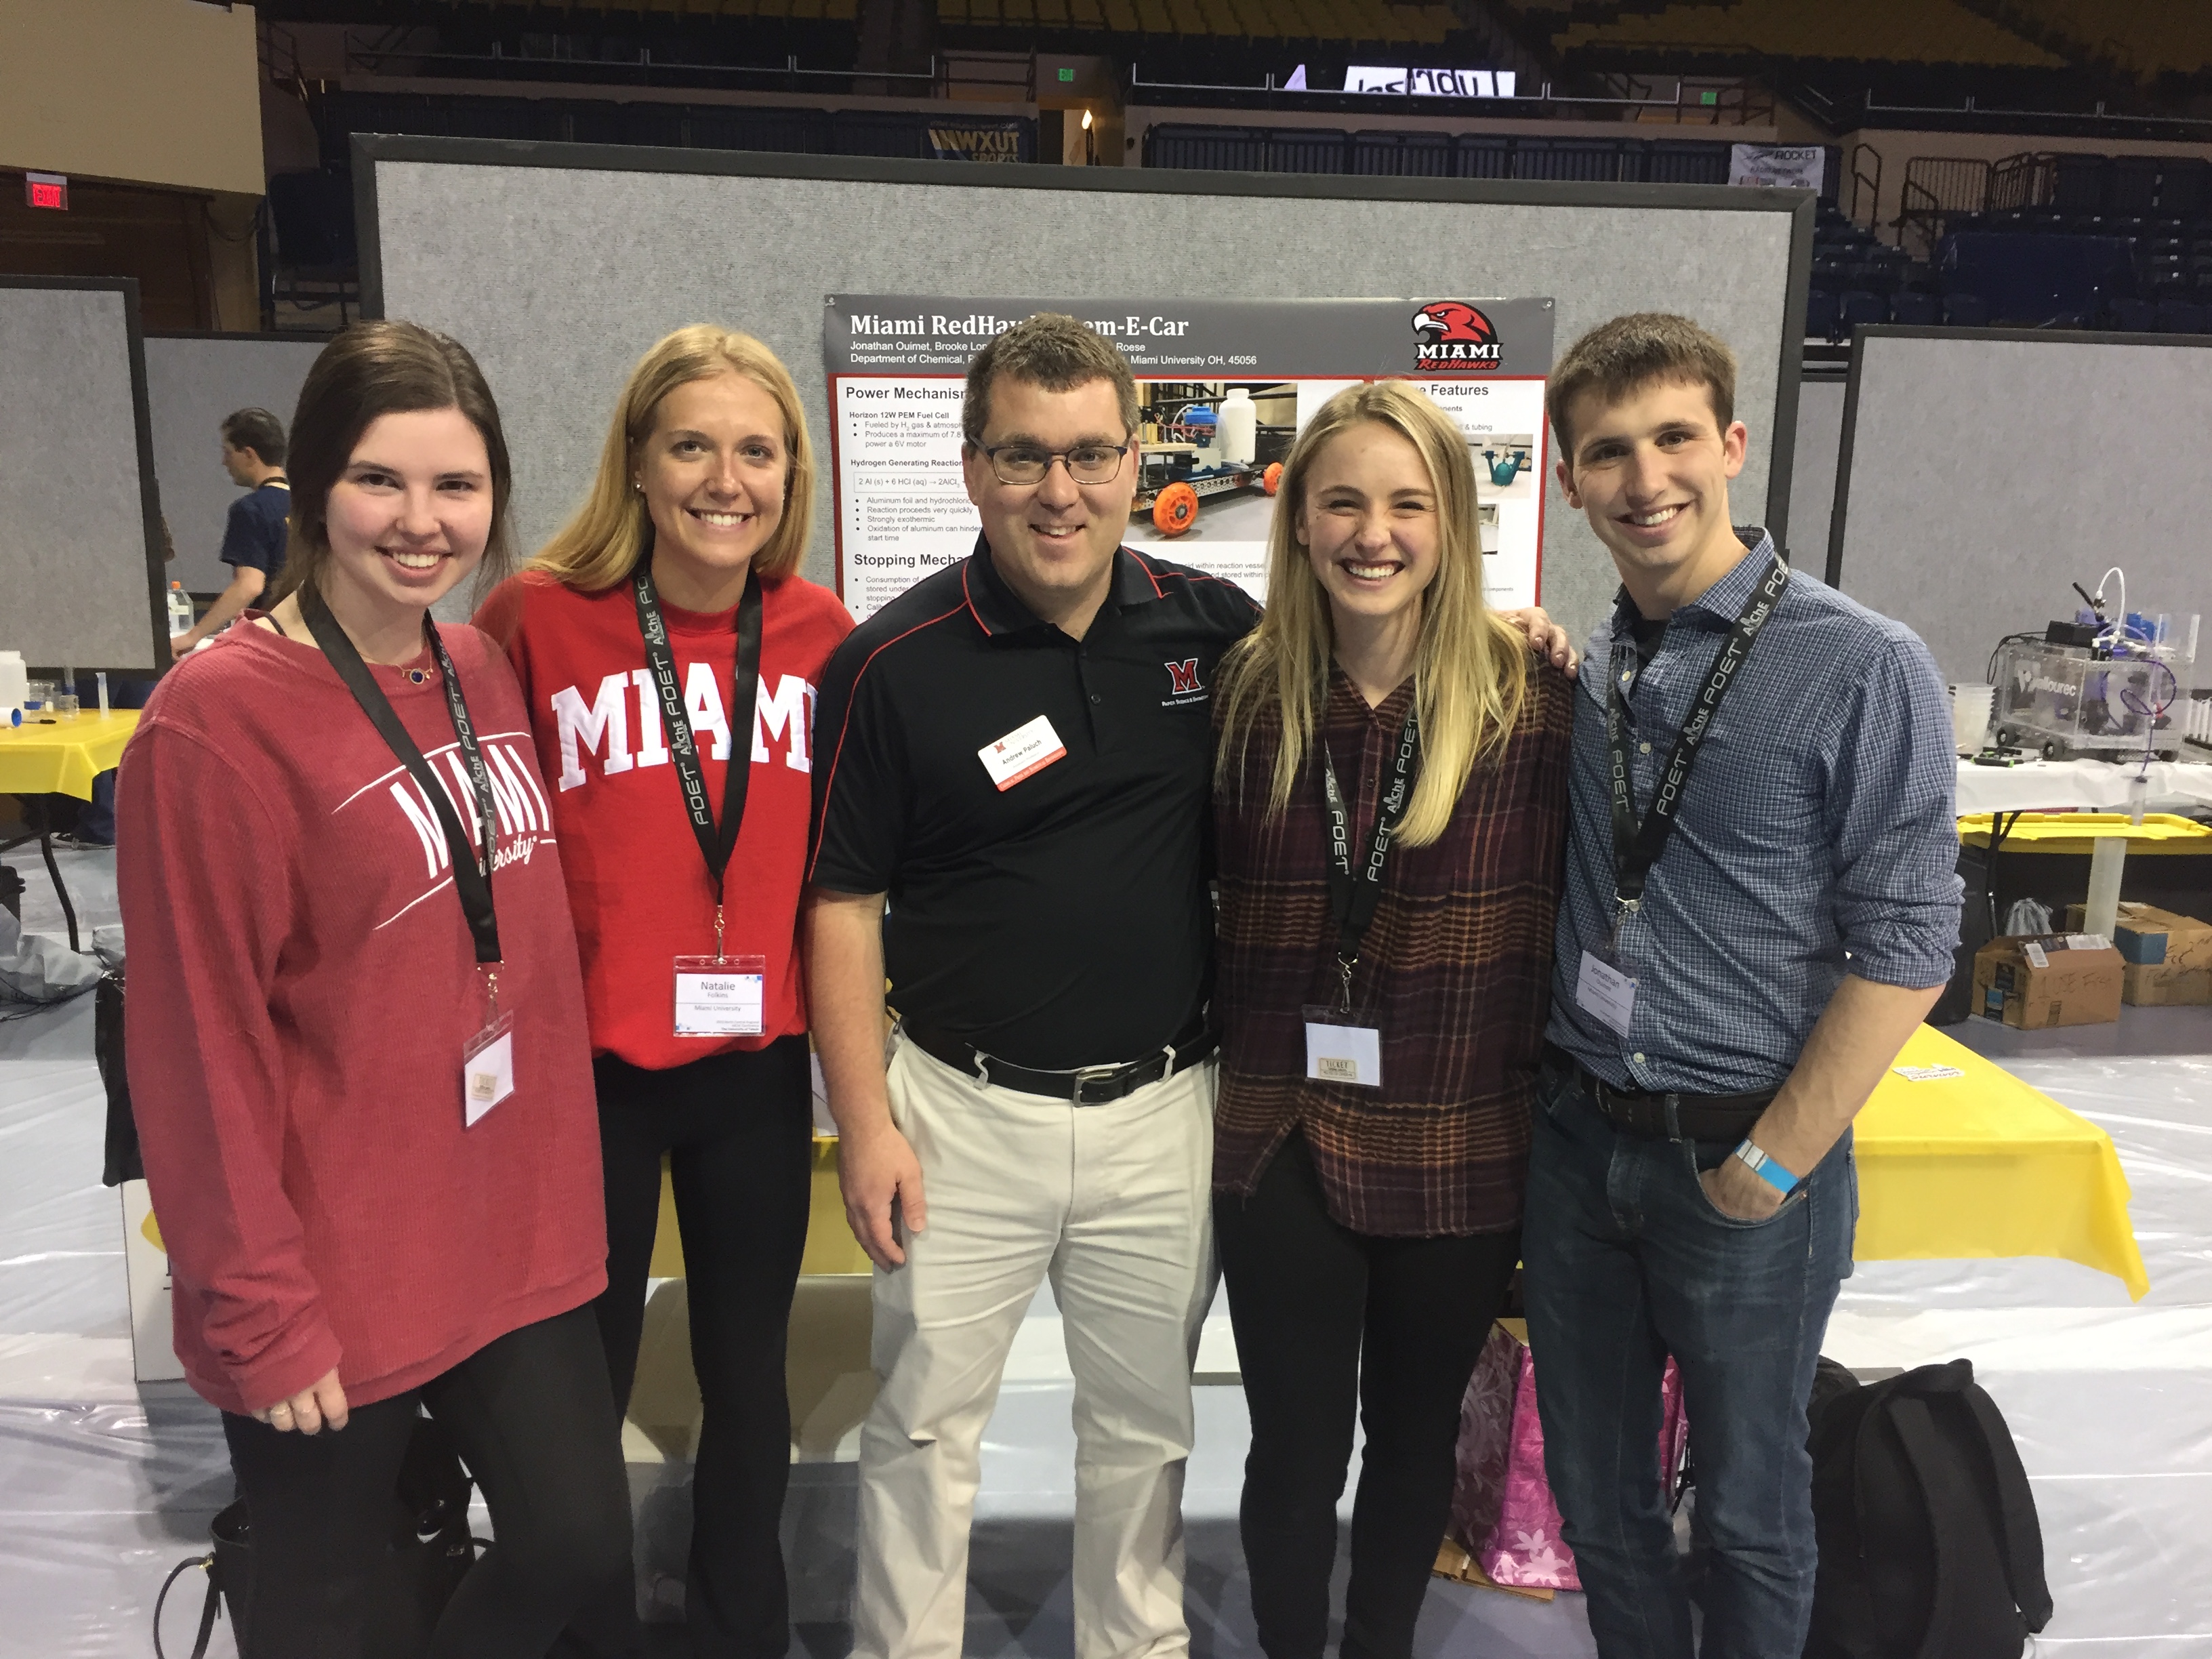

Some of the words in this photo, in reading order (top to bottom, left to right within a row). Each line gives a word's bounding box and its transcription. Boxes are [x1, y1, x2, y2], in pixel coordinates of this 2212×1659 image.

[1774, 150, 1817, 160] ROCKET
[851, 314, 925, 335] Miami
[851, 341, 893, 350] Jonathan
[896, 342, 933, 352] Ouimet,
[935, 342, 968, 350] Brooke
[1116, 342, 1145, 352] Roese
[1417, 344, 1500, 359] MIAMI
[851, 354, 905, 365] Department
[907, 354, 917, 363] of
[919, 354, 965, 365] Chemical,
[1130, 355, 1158, 365] Miami
[1161, 355, 1205, 367] University
[1208, 356, 1225, 366] OH,
[1228, 356, 1256, 365] 45056
[846, 387, 889, 398] Power
[1431, 384, 1489, 396] Features
[890, 422, 899, 430] by
[851, 459, 886, 468] Hydrogen
[888, 459, 929, 468] Generating
[913, 478, 926, 487] (aq)
[949, 507, 973, 515] quickly
[854, 554, 915, 568] Stopping
[1764, 559, 1788, 597] POE
[1164, 657, 1202, 695] M
[1704, 638, 1741, 704] POET
[452, 688, 476, 750] POET
[653, 653, 684, 716] POET
[683, 768, 709, 825] POET
[1002, 752, 1023, 764] Andrew
[1023, 739, 1042, 753] Paluch
[1612, 749, 1629, 809] POET
[1656, 751, 1687, 815] POET
[1331, 810, 1348, 871] POET
[1367, 819, 1391, 882] POET
[701, 981, 736, 990] Natalie
[1326, 1060, 1348, 1069] TICKET
